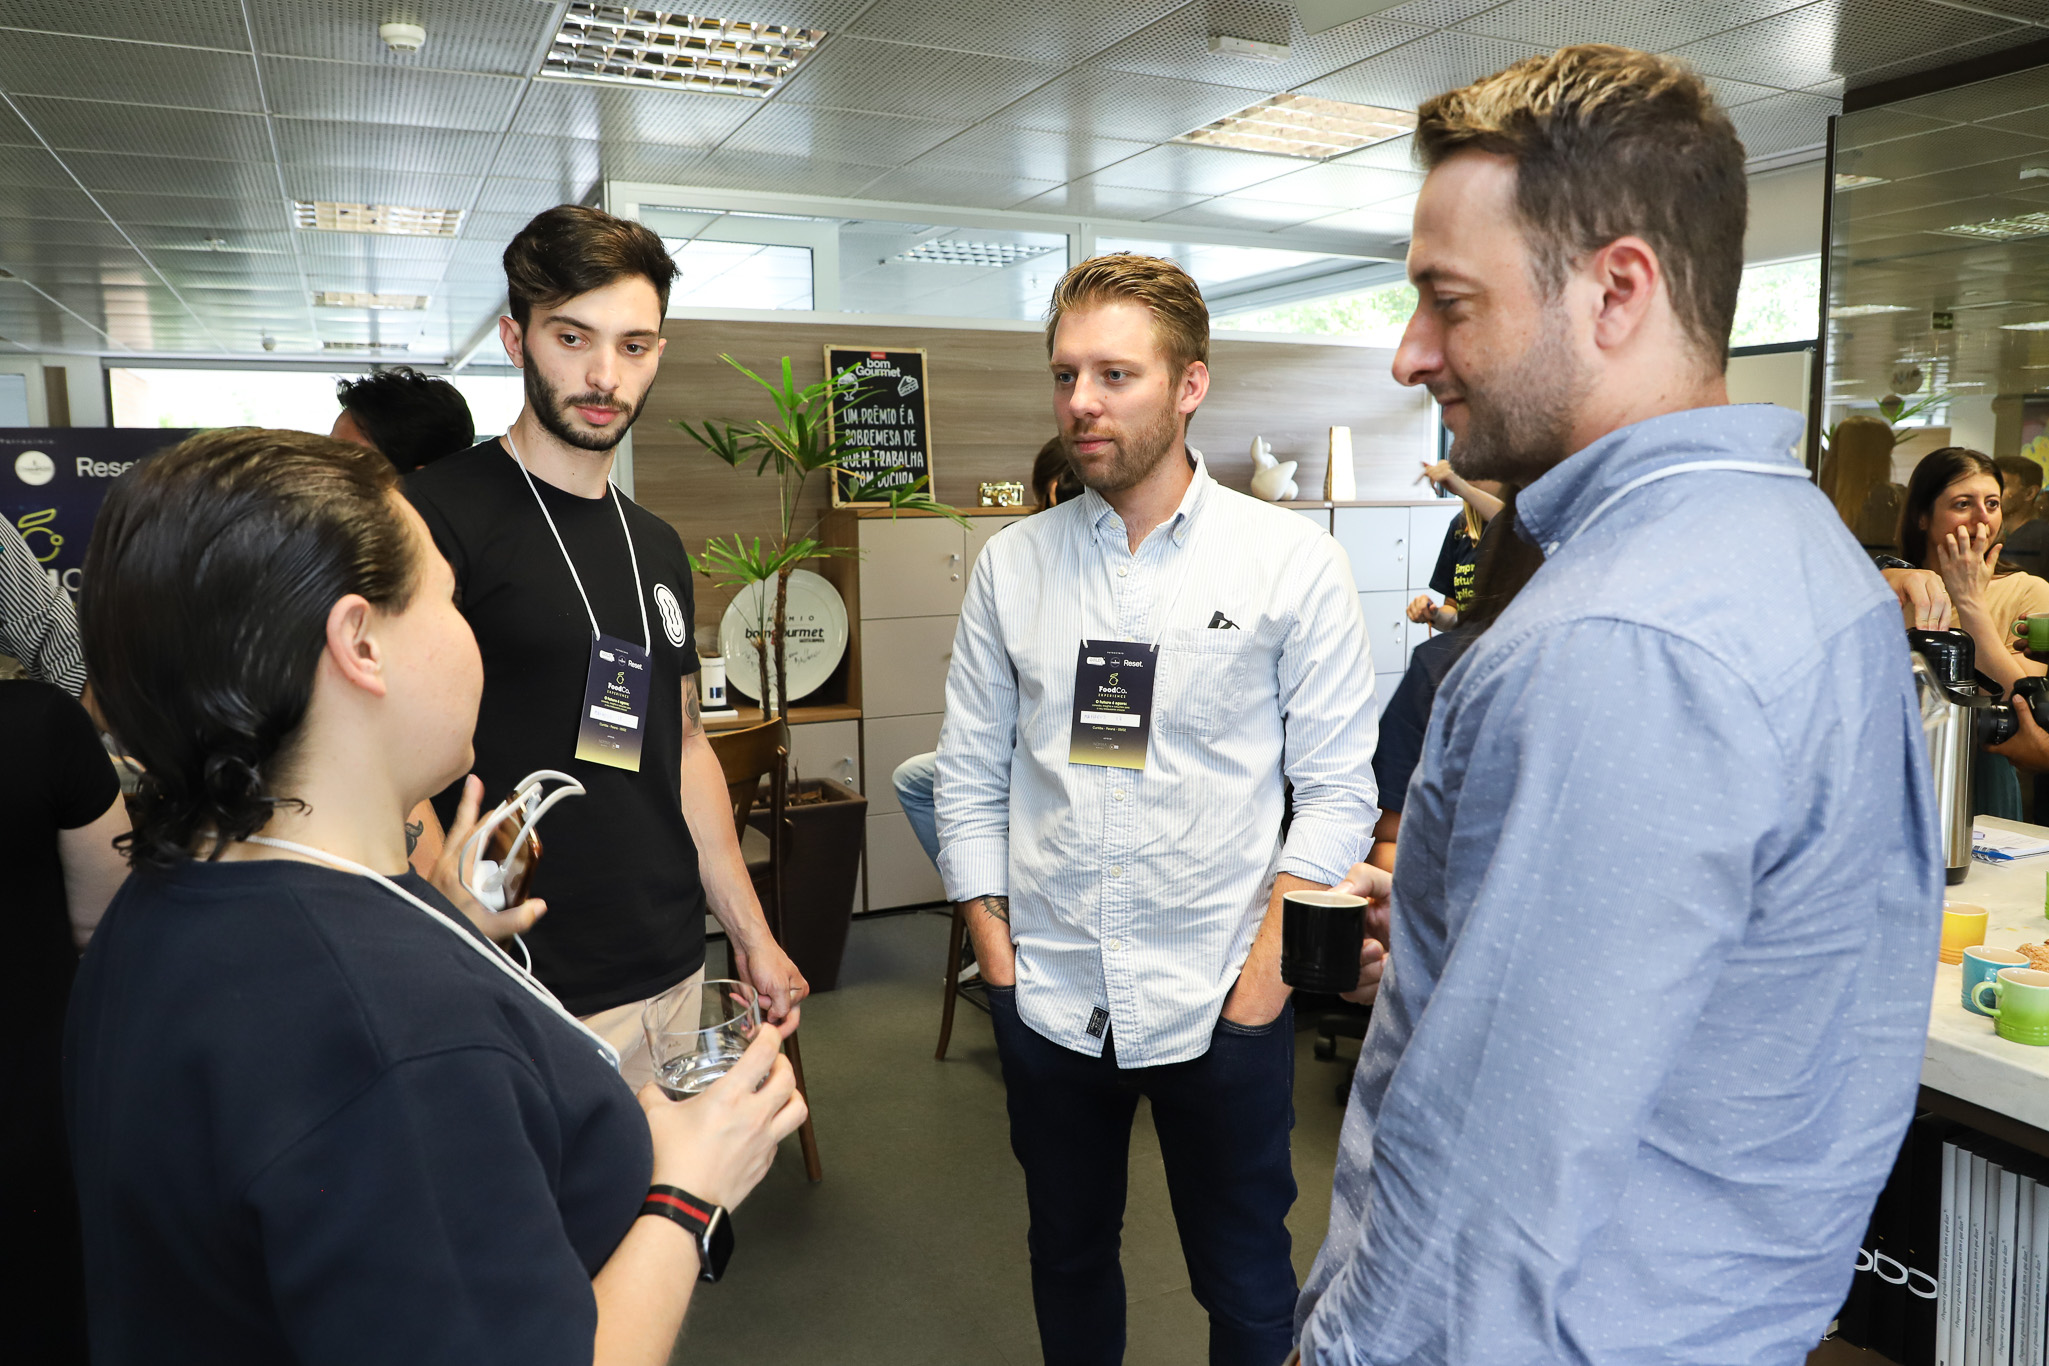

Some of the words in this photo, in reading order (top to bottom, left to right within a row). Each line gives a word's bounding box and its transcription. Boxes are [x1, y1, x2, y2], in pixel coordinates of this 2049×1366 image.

[855, 366, 901, 377] Gourmet
[866, 358, 890, 368] bom
[843, 408, 858, 424] UM
[861, 405, 897, 425] PRÊMIO
[900, 404, 906, 425] É
[908, 409, 914, 425] A
[846, 428, 901, 446] SOBREMESA
[904, 430, 917, 446] DE
[76, 456, 140, 478] Rese
[873, 450, 924, 468] TRABALHA
[1099, 686, 1127, 694] FoodCo.
